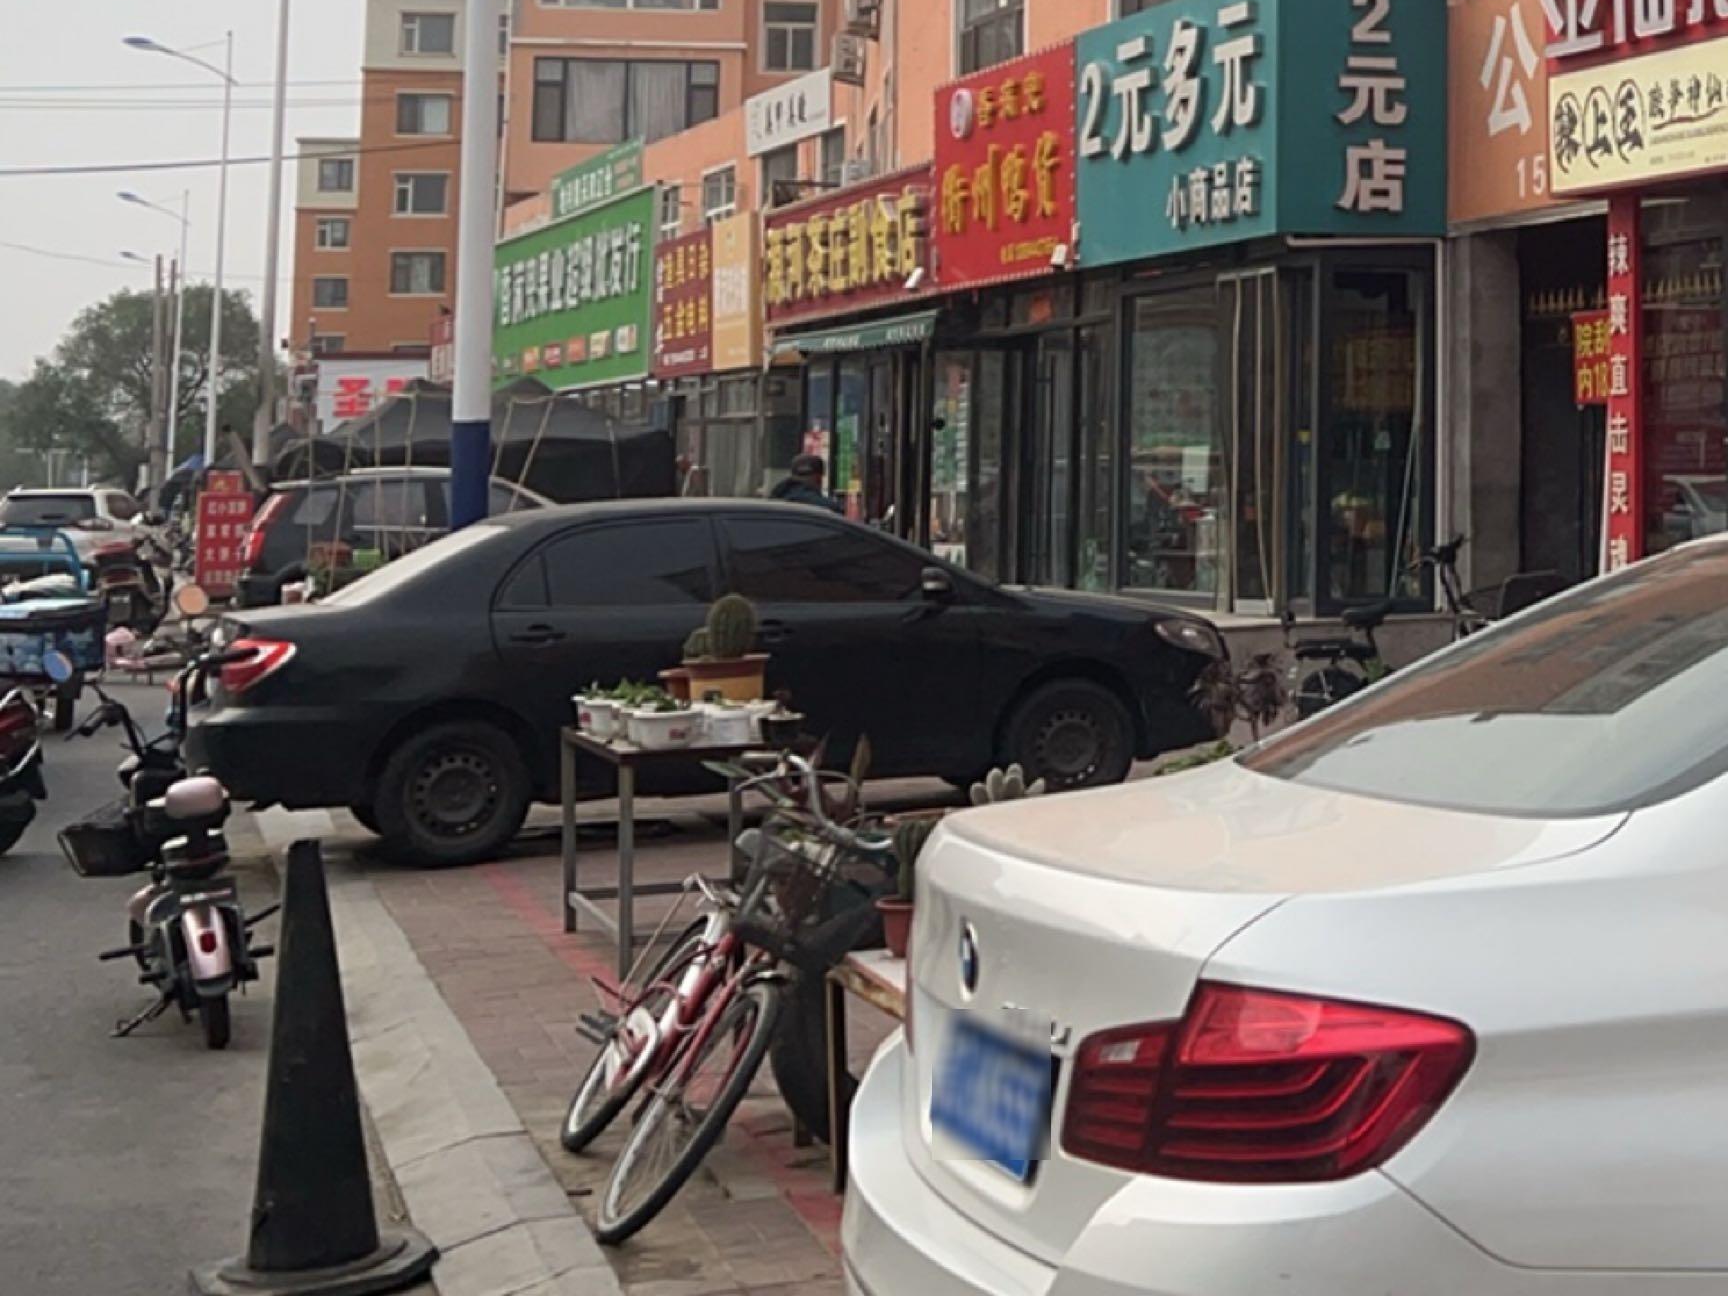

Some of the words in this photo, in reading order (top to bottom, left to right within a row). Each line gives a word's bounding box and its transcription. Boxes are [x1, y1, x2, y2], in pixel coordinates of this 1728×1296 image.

[1079, 0, 1258, 160] 2元多元
[1166, 155, 1258, 228] 小商品店
